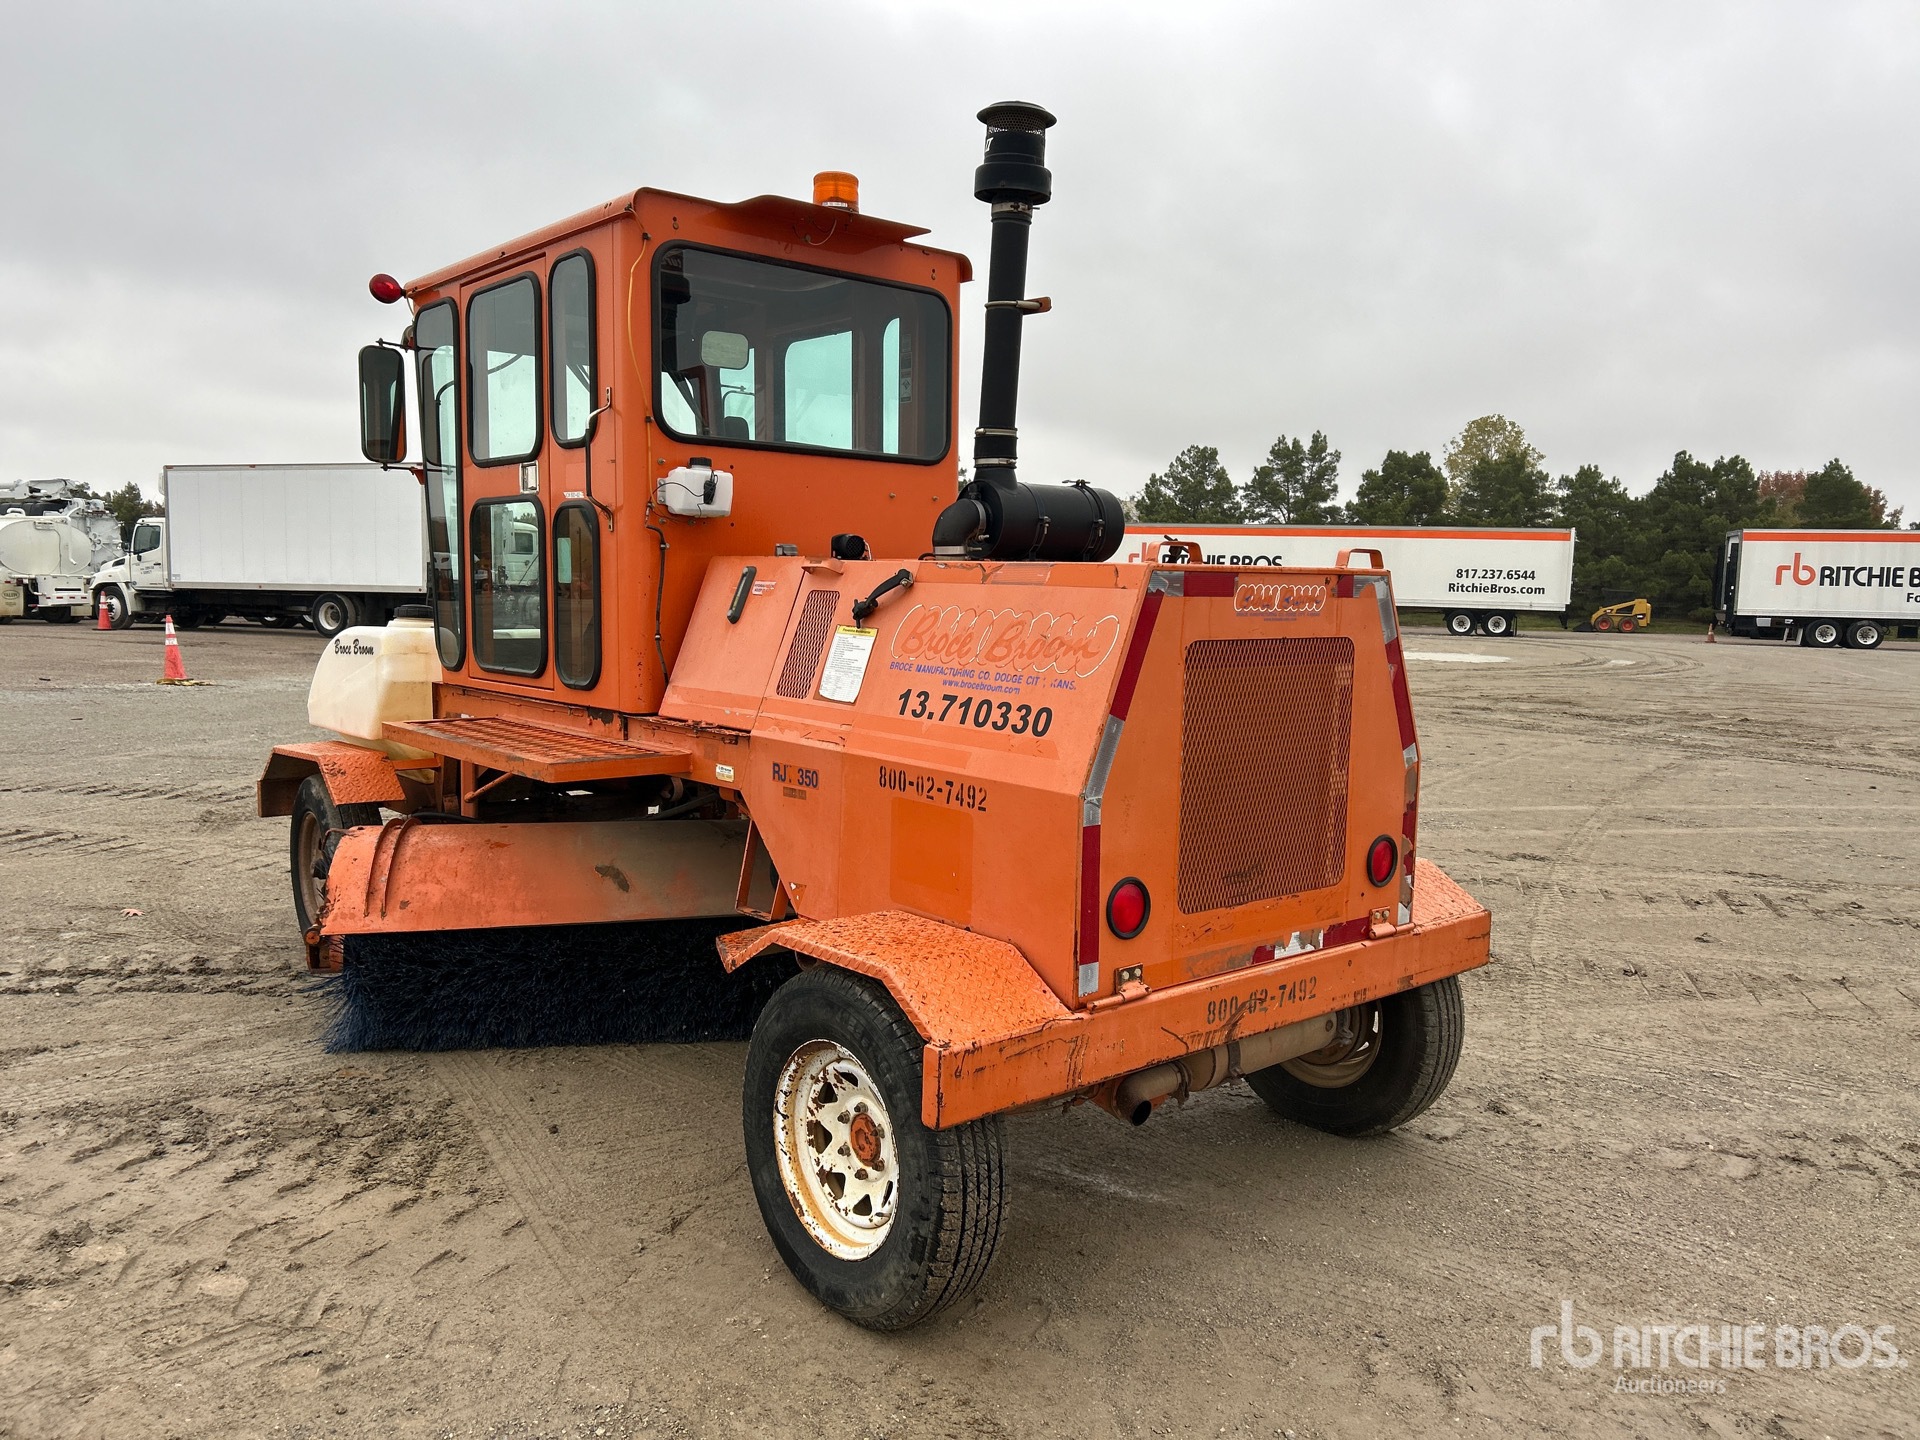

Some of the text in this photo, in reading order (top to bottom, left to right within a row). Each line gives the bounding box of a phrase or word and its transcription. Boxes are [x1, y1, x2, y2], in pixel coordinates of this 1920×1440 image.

[1456, 568, 1536, 580] 817.237.6544
[1775, 552, 1816, 585] rb
[1819, 566, 1905, 587] RITCHIE
[1448, 582, 1545, 595] RitchieBros.com
[353, 638, 375, 656] Broom
[889, 661, 914, 672] BROCE
[915, 664, 975, 679] MANUFACTURING
[978, 671, 991, 680] CO.
[994, 672, 1023, 684] DODGE
[898, 688, 1053, 738] 13.710330
[772, 763, 819, 789] RJ 350
[879, 765, 988, 812] 800-02-7492
[1207, 976, 1317, 1025] 80002-7492
